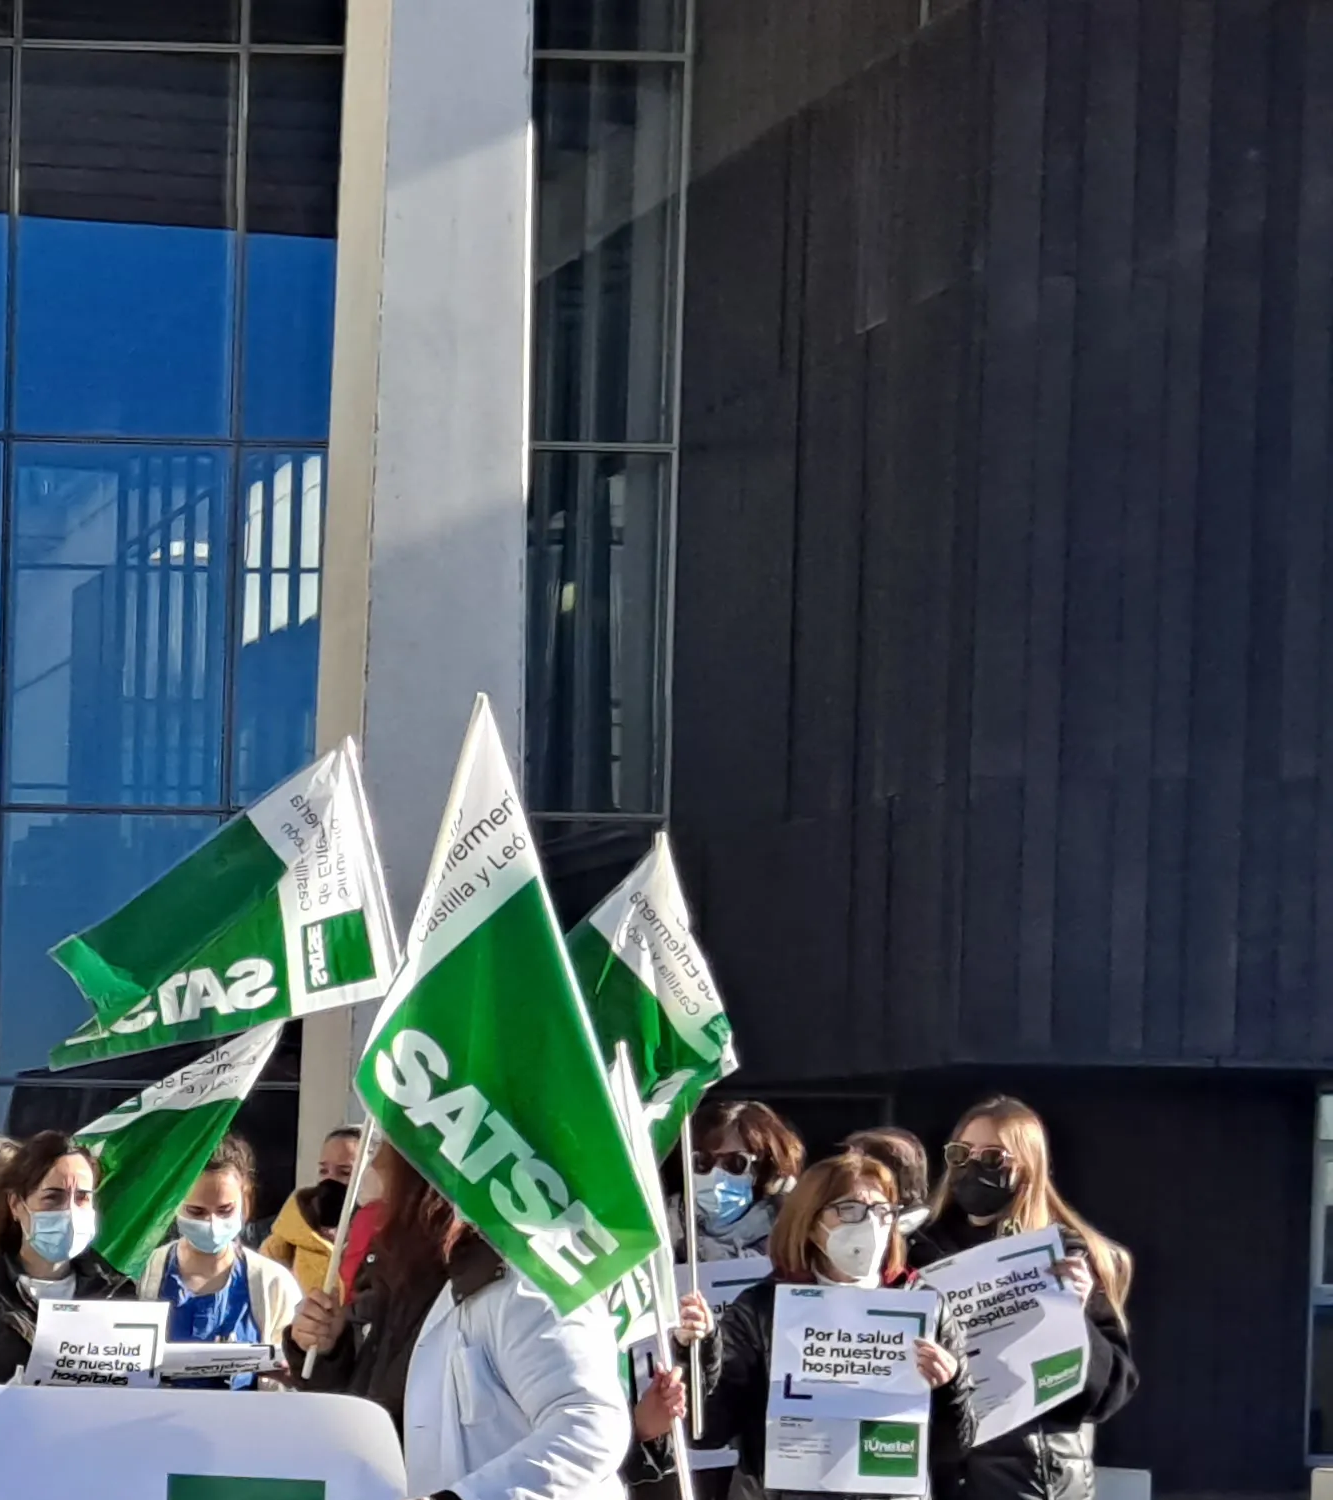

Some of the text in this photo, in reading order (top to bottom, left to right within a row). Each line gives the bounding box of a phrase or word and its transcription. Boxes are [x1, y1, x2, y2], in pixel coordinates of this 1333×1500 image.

[474, 867, 490, 888] y
[487, 832, 527, 870] Leó
[375, 1029, 620, 1286] SATSE
[946, 1266, 1041, 1303] Por la salud
[952, 1281, 1047, 1318] de nuestros
[957, 1297, 1040, 1332] hospitales
[59, 1341, 141, 1357] Por la salud
[804, 1327, 905, 1345] Por la salud
[55, 1356, 141, 1373] de nuestros
[803, 1343, 907, 1361] de nuestros
[802, 1359, 893, 1377] hospitales
